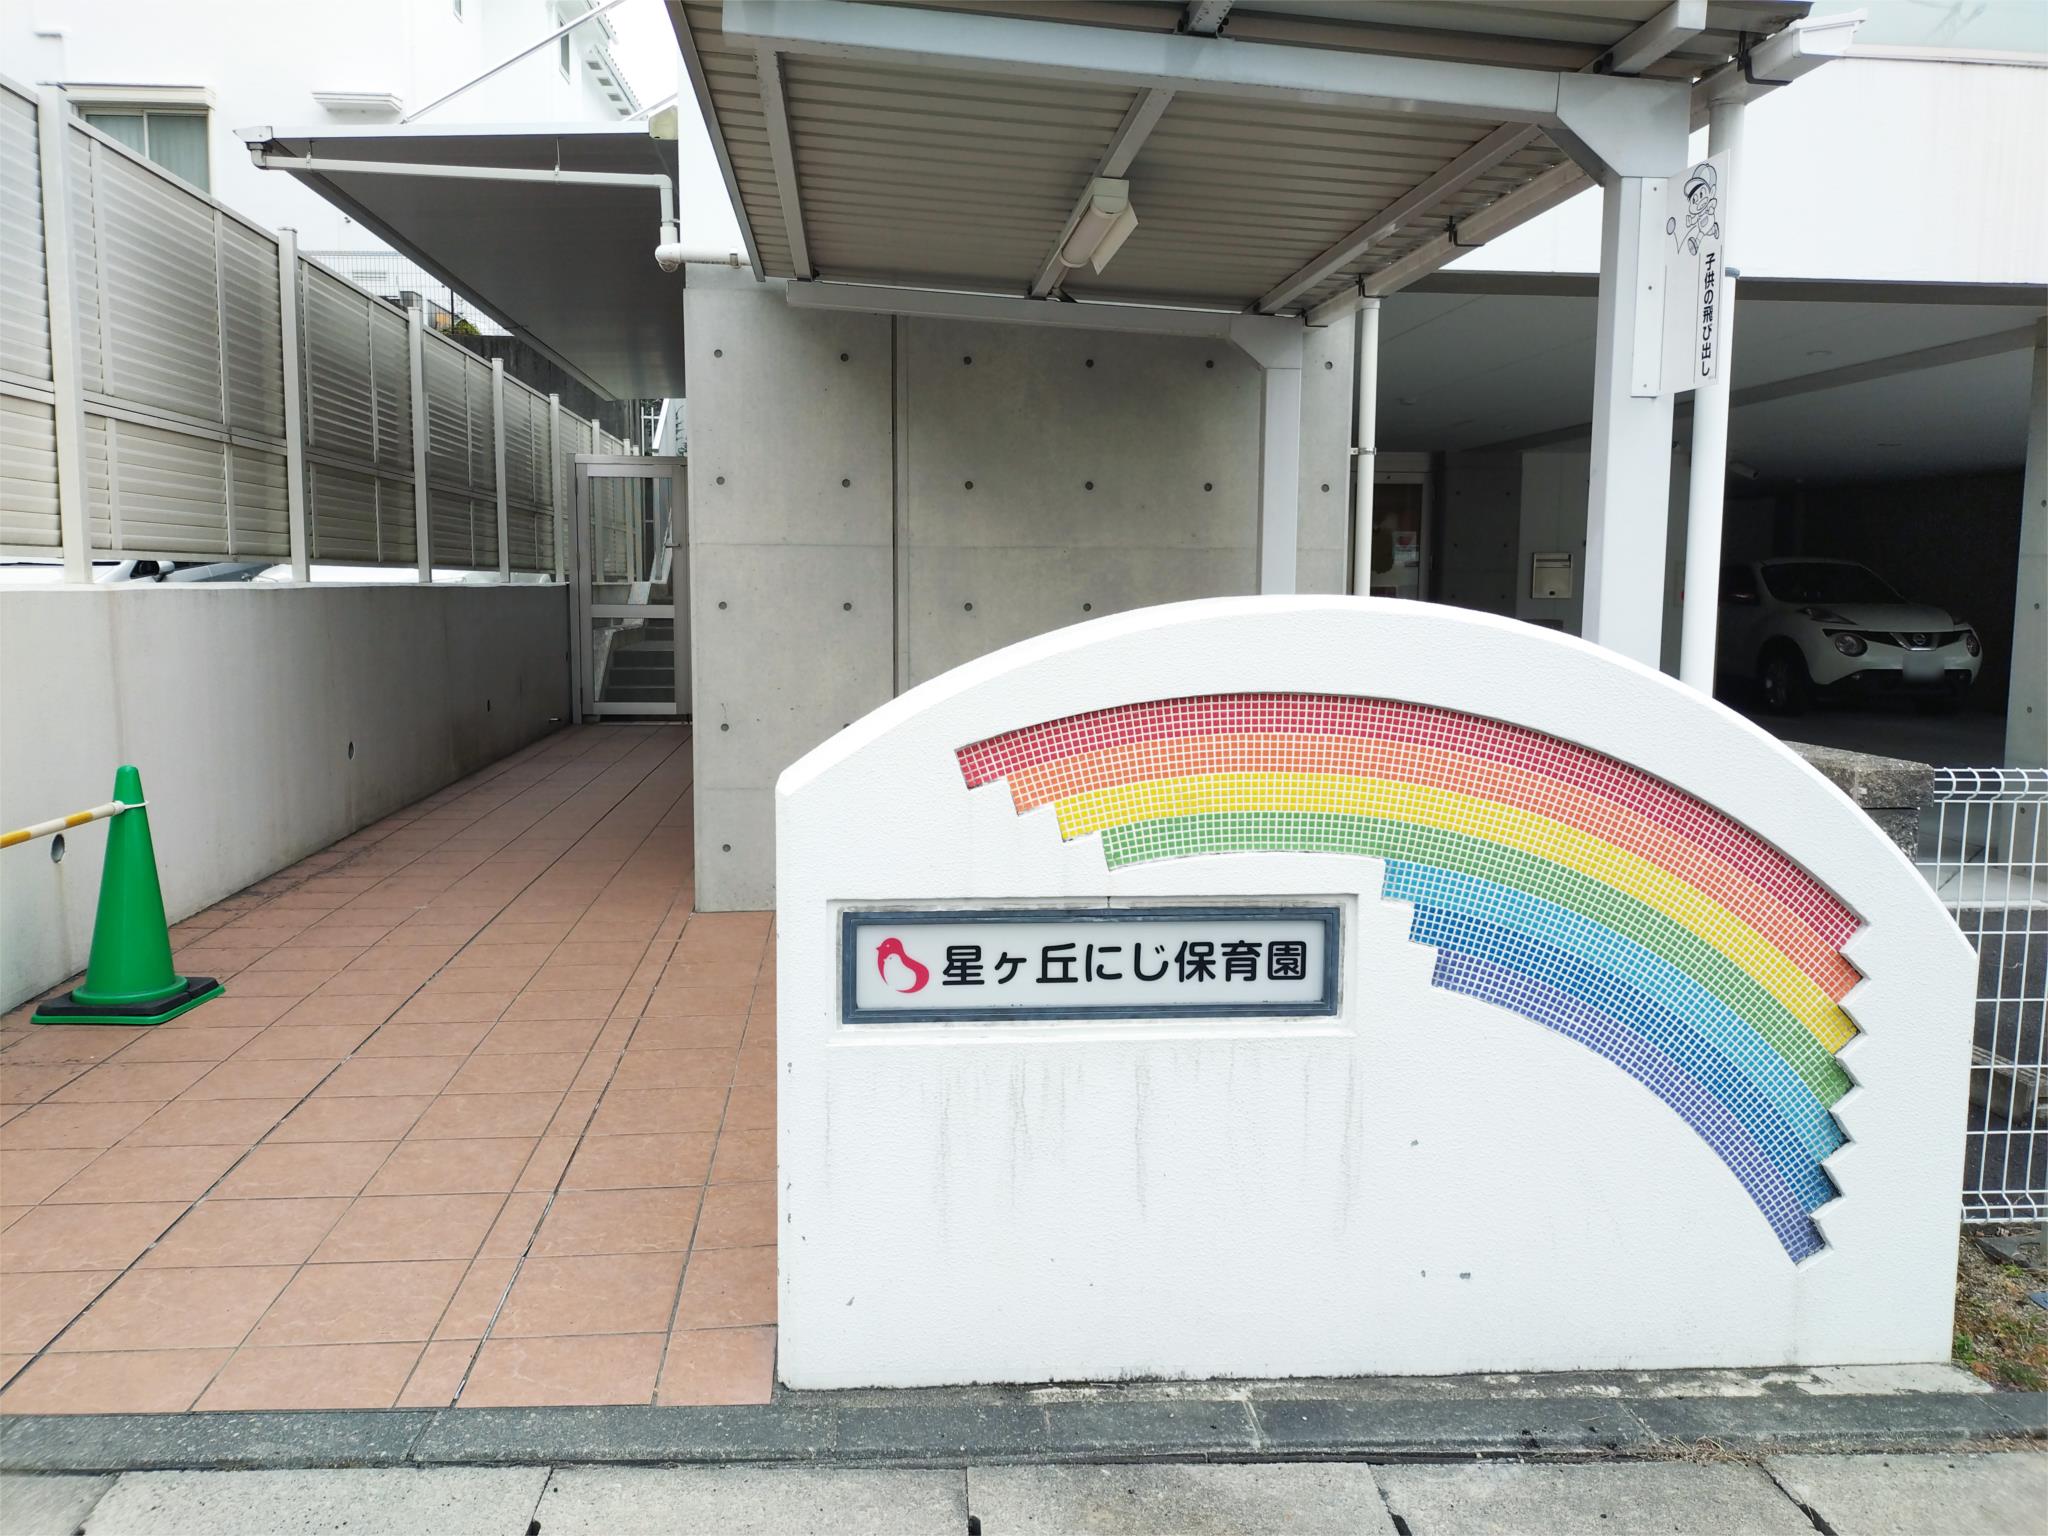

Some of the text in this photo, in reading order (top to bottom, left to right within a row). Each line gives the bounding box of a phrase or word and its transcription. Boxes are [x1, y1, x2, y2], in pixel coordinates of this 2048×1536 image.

[1701, 252, 1716, 377] 子供の飛び出し
